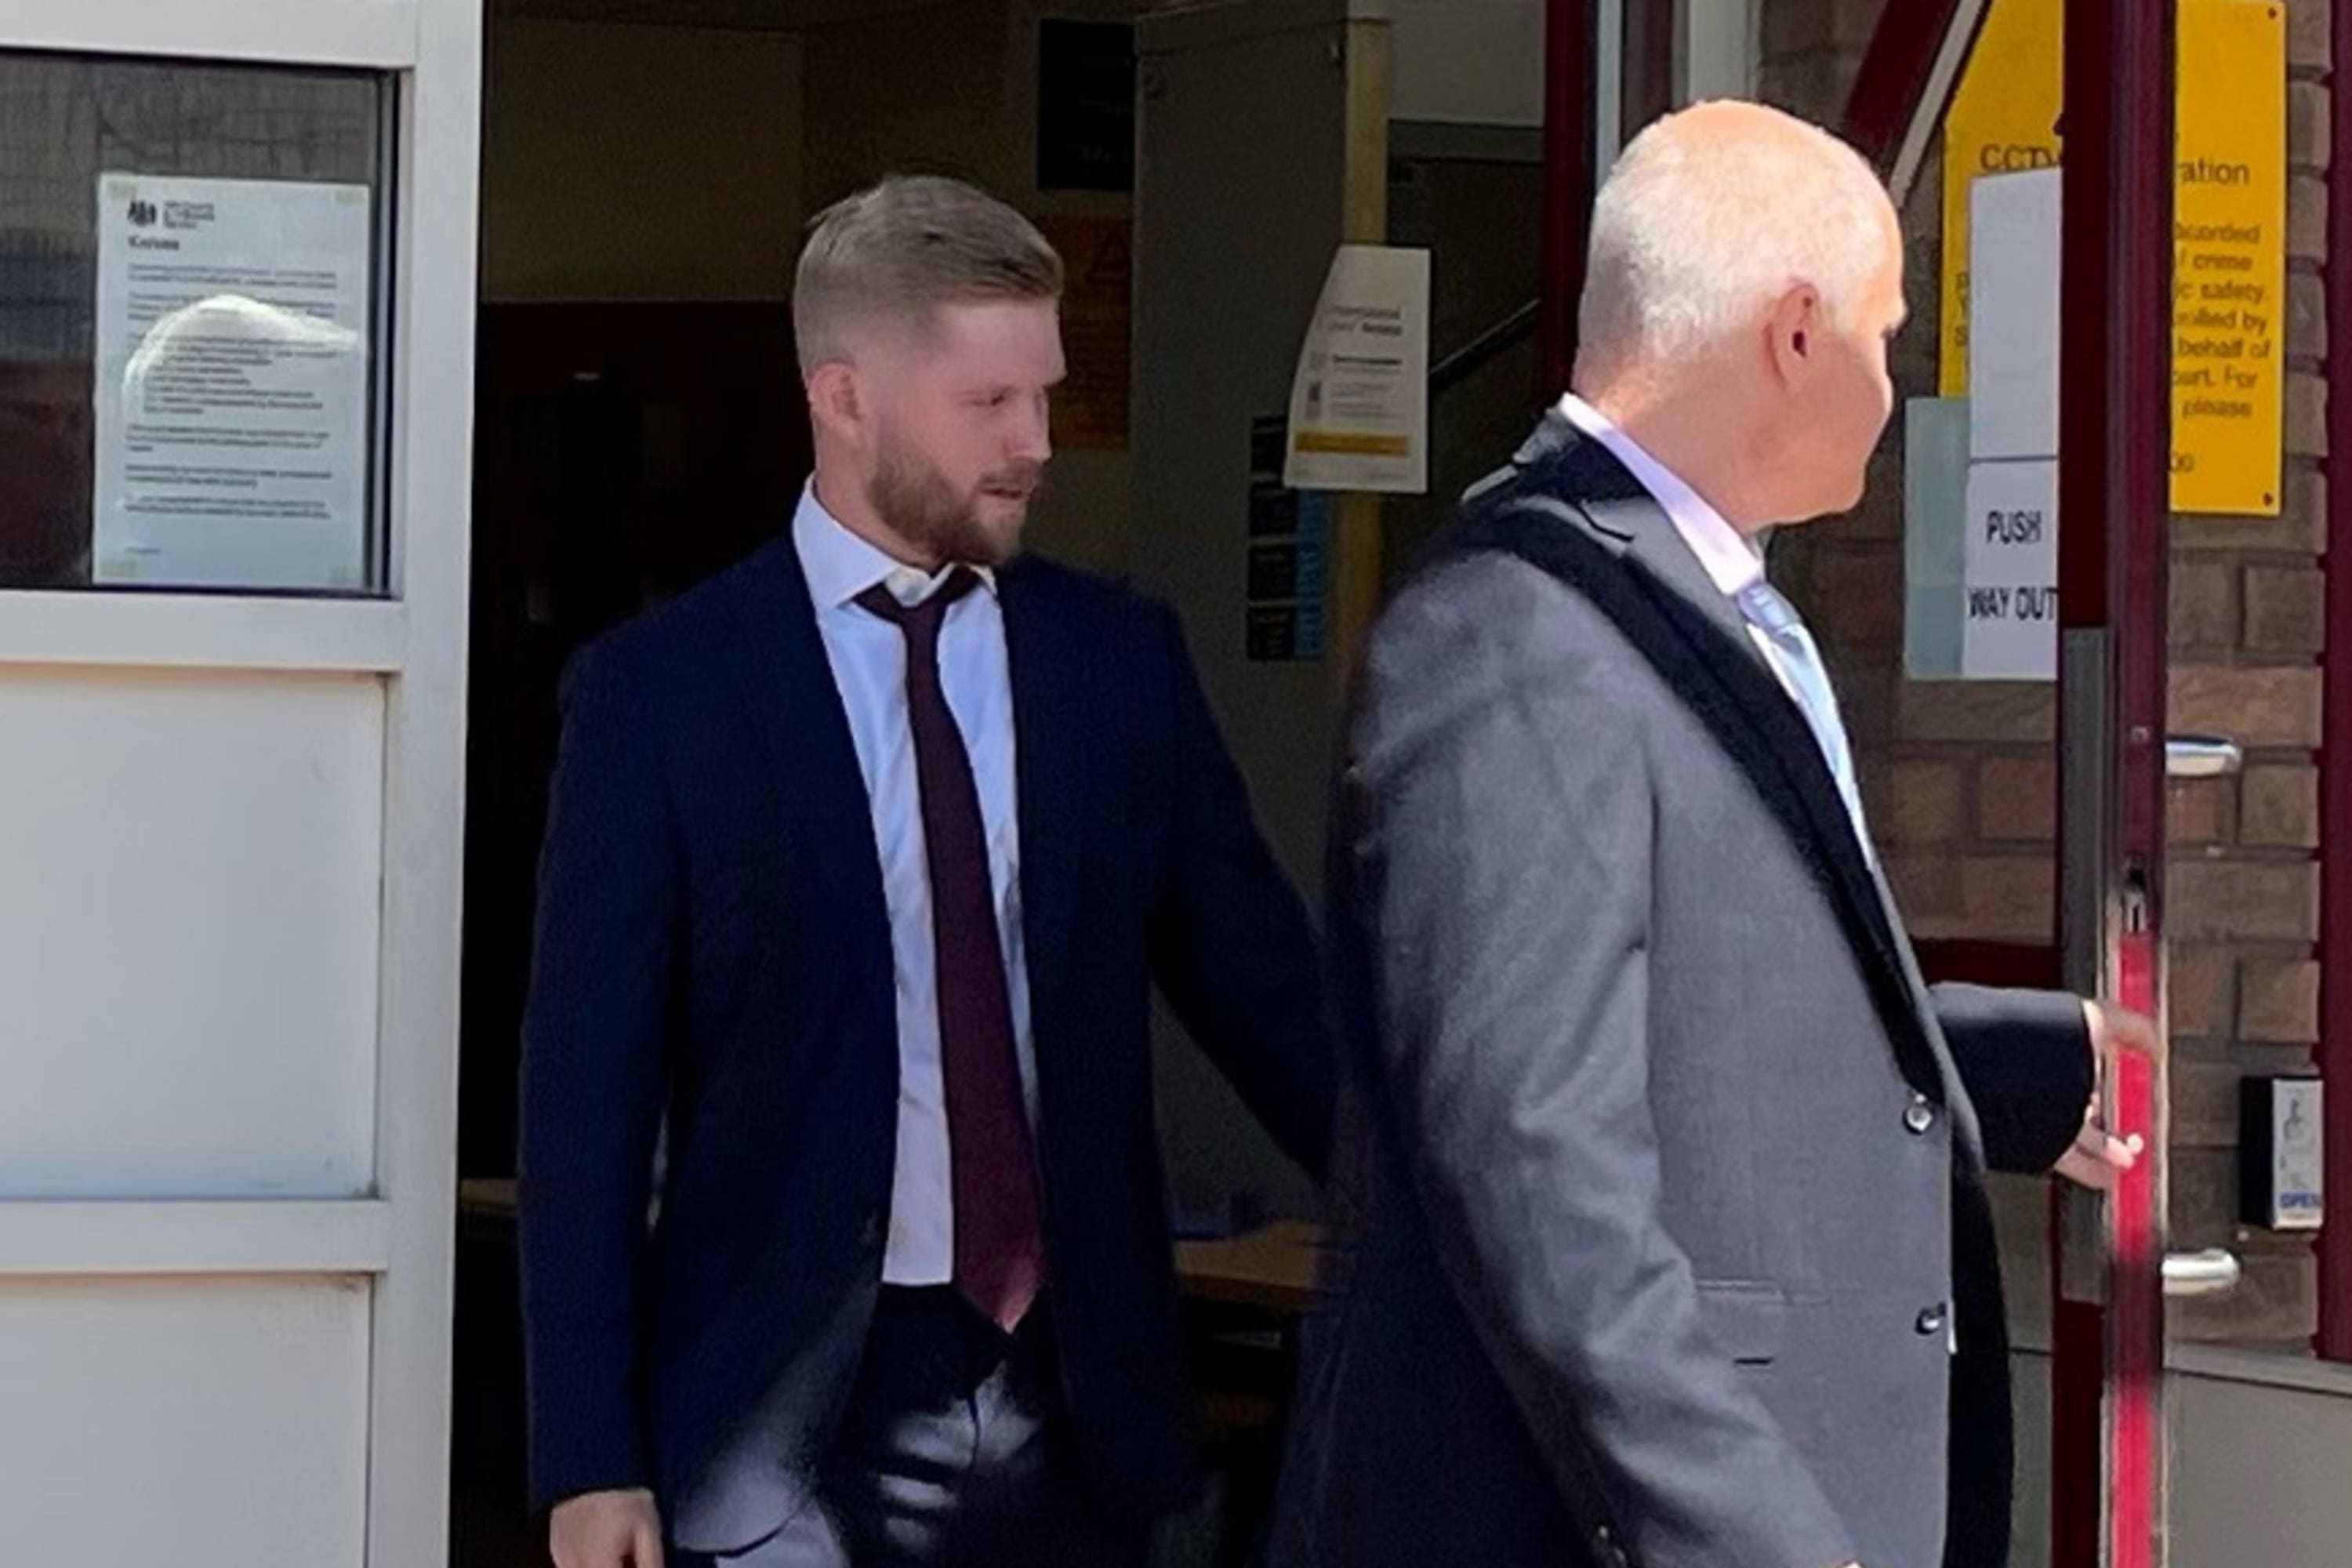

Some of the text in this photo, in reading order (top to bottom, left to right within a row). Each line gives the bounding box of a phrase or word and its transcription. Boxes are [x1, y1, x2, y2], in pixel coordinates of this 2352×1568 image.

[2201, 280, 2263, 305] safety
[2244, 311, 2267, 336] by
[2179, 336, 2271, 358] behalf of
[2224, 364, 2258, 389] For
[2183, 397, 2252, 418] please
[1987, 510, 2042, 543] PUSH
[1969, 586, 2059, 619] WAY OUT
